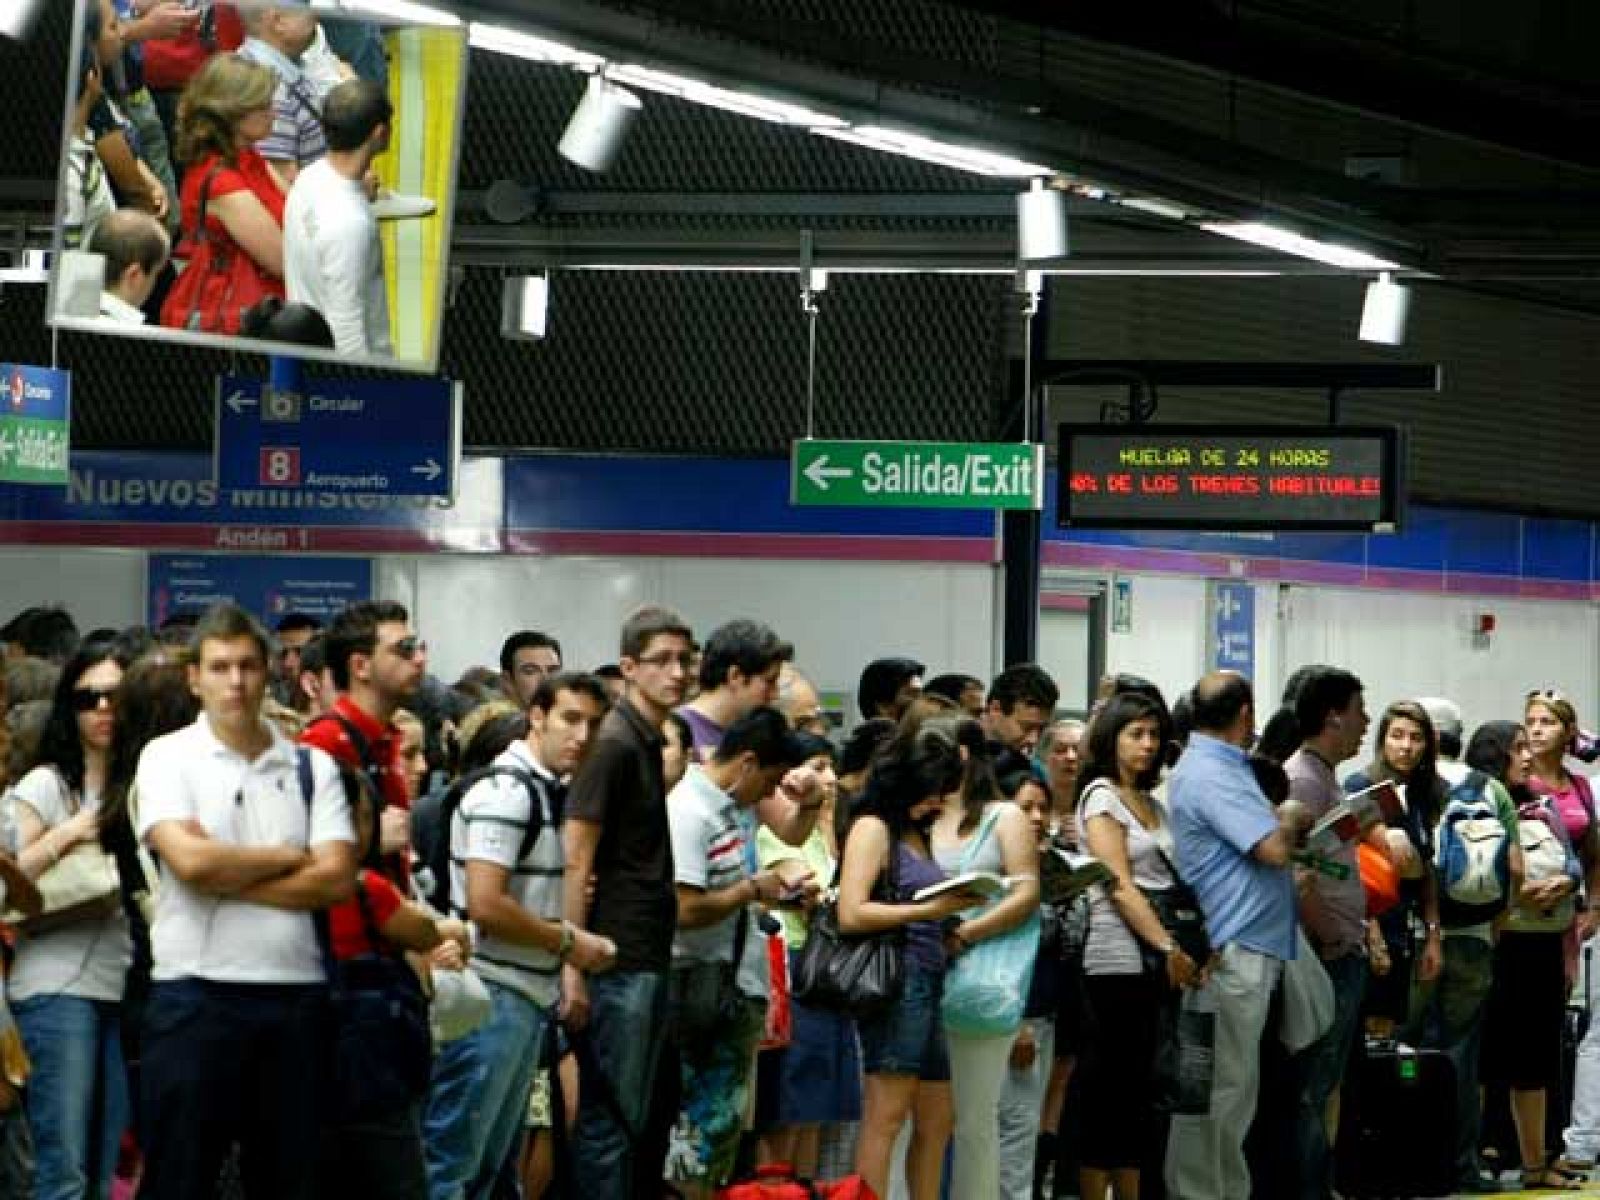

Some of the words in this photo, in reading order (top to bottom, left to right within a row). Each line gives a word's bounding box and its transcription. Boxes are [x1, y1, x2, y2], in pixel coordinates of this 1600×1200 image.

[270, 450, 291, 482] 8
[306, 471, 390, 489] Aeropuerto
[1119, 449, 1191, 466] HUELGA
[1202, 449, 1226, 466] DE
[1238, 449, 1259, 466] 24
[1269, 449, 1330, 466] HORAS
[66, 468, 219, 506] Nuevos
[862, 452, 1032, 496] Salida/Exit
[1106, 474, 1133, 493] DE
[1141, 475, 1179, 493] LOS
[1189, 475, 1260, 496] TRENES
[299, 529, 308, 548] 1
